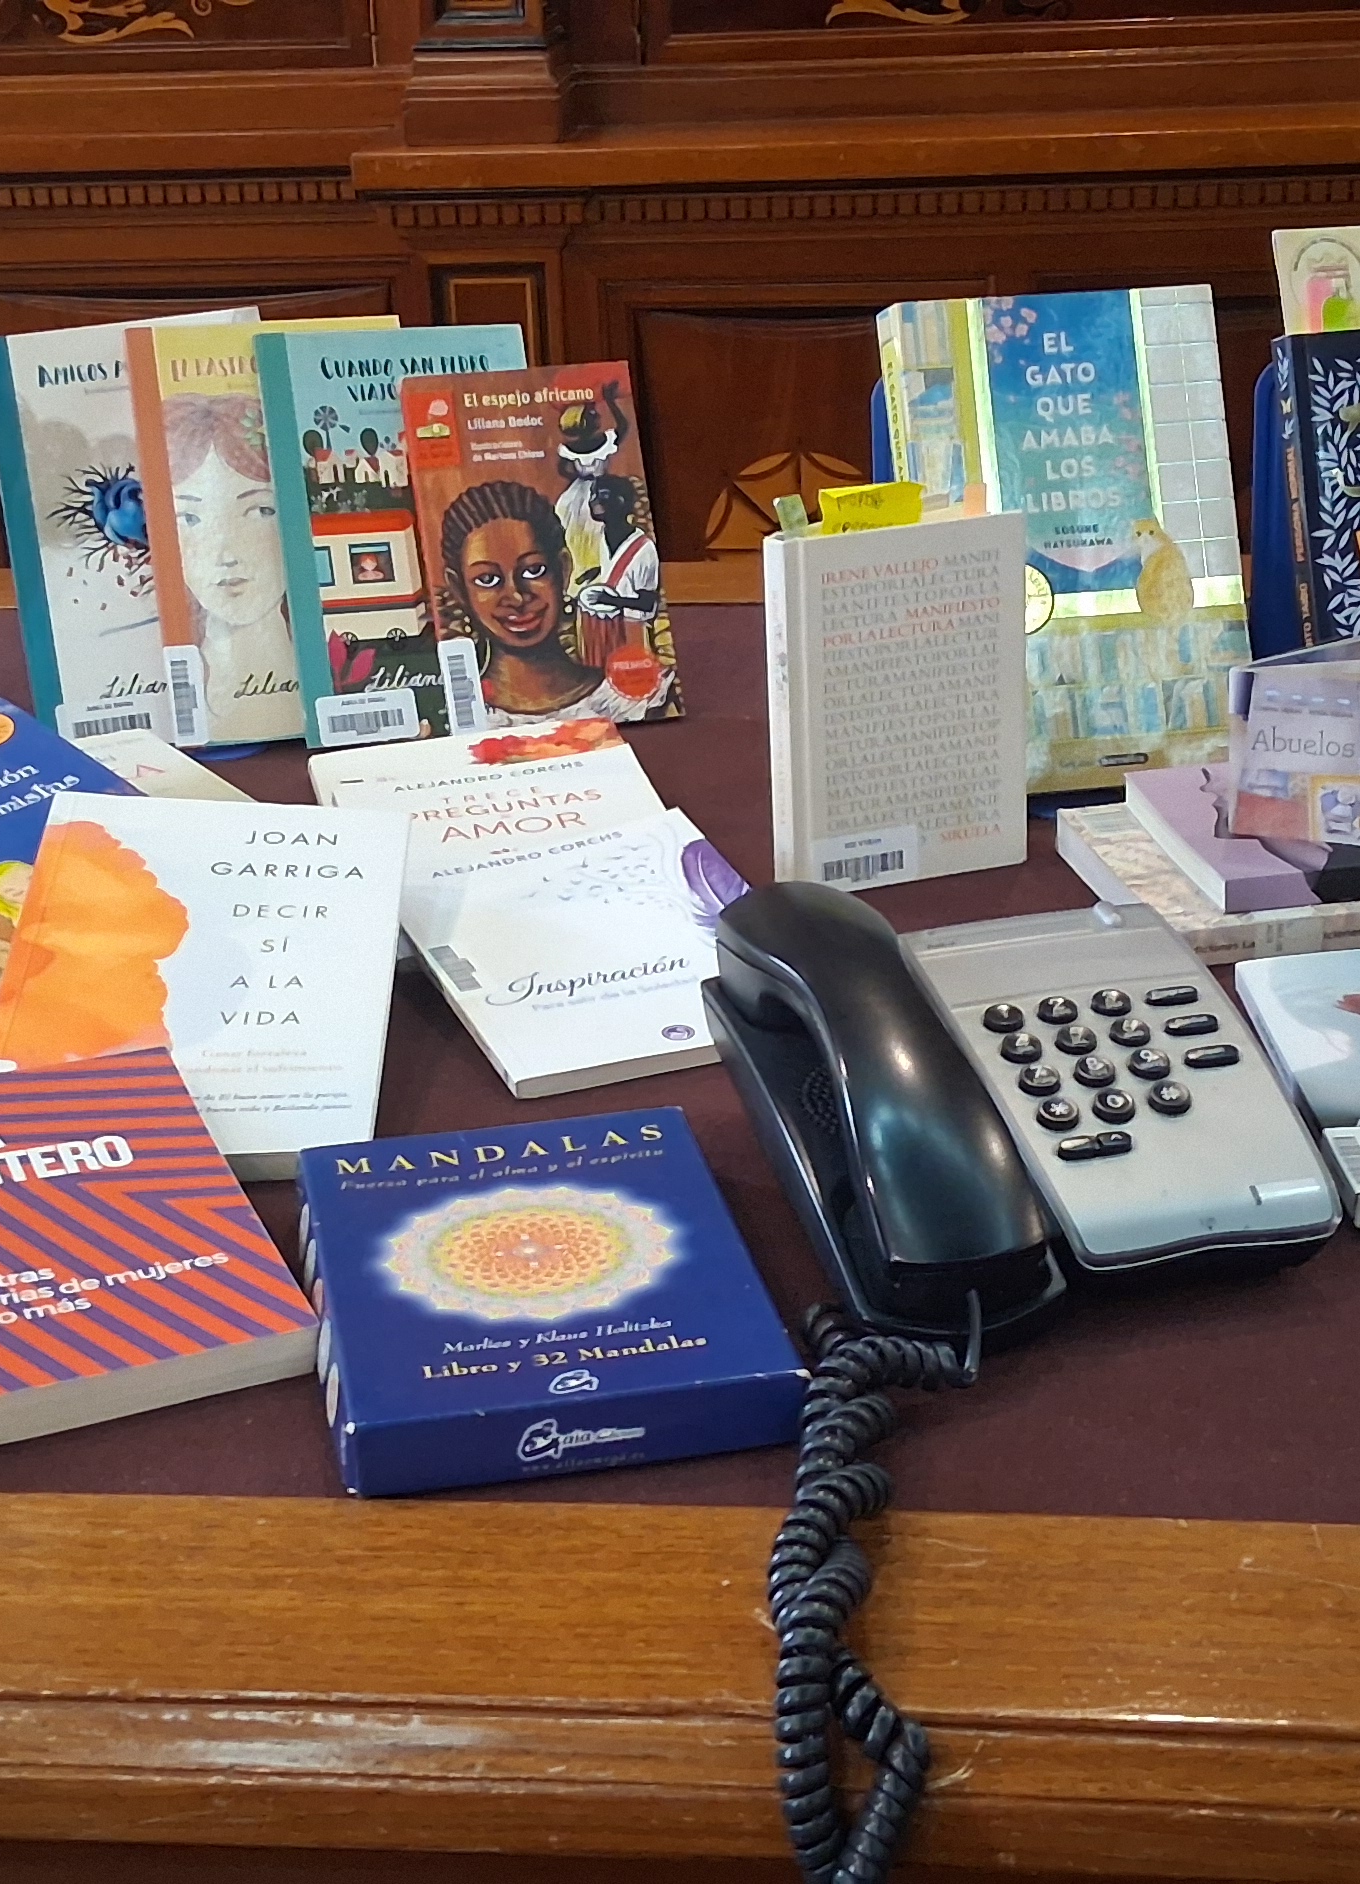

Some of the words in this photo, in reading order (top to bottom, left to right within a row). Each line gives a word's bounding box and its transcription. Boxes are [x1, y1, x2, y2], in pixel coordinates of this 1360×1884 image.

[1043, 332, 1074, 354] EL
[38, 362, 108, 387] AMIGOS
[321, 356, 394, 380] CUANDO
[400, 357, 435, 376] SAN
[1026, 362, 1095, 384] GATO
[463, 393, 478, 408] El
[482, 389, 530, 409] espejo
[534, 387, 594, 404] africano
[1036, 393, 1092, 422] QUE
[1022, 425, 1116, 451] AMABA
[1046, 457, 1096, 480] LOS
[1024, 486, 1122, 514] LIBROS
[1251, 726, 1356, 759] Abuelos
[393, 773, 503, 793] ALEJANDRO
[510, 760, 585, 778] CORCHS
[245, 830, 339, 847] JOAN
[442, 810, 587, 844] AMOR
[431, 851, 541, 880] ALEJANDRO
[548, 830, 624, 855] CORCHS
[210, 860, 365, 880] GARRIGA
[233, 903, 329, 919] DECIR
[260, 936, 290, 953] SÍ
[230, 974, 249, 989] A
[268, 975, 304, 990] LA
[486, 955, 690, 1007] Inspiración
[220, 1010, 301, 1026] VIDA
[335, 1123, 665, 1176] MANDALAS
[416, 1172, 460, 1187] para
[469, 1168, 485, 1180] el
[492, 1164, 538, 1178] alma
[58, 1277, 101, 1295] de
[106, 1251, 230, 1289] mujeres
[22, 1297, 92, 1320] más
[442, 1337, 513, 1356] Marlies
[535, 1329, 589, 1345] Klaus
[422, 1360, 499, 1380] Libro
[507, 1360, 521, 1373] y
[532, 1351, 569, 1367] 32
[578, 1335, 708, 1362] Mandalas
